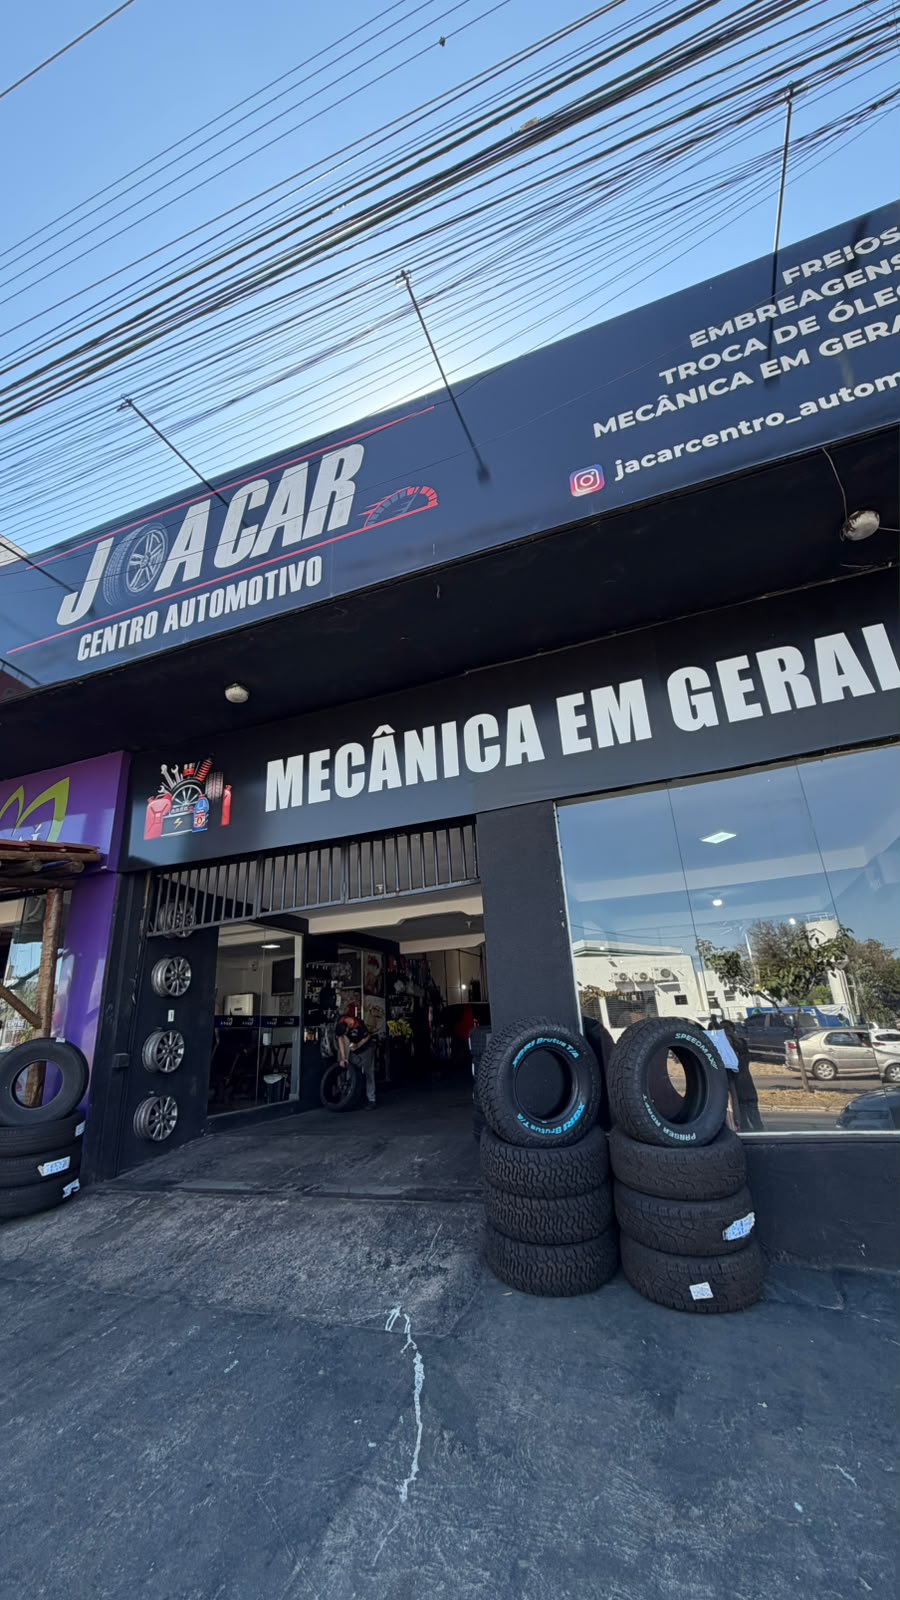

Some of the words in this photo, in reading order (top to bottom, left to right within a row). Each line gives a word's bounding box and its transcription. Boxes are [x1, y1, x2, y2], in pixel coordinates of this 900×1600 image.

[659, 337, 768, 385] TROCA
[773, 315, 821, 345] DE
[827, 284, 900, 323] ÓLE
[593, 371, 754, 438] MECÂNICA
[760, 349, 810, 379] EM
[213, 443, 366, 569] CAR
[77, 611, 158, 662] CENTRO
[163, 555, 323, 635] AUTOMOTIVO
[265, 703, 545, 813] MECÂNICA
[556, 678, 652, 756] EM
[667, 623, 900, 732] GERAL
[536, 1037, 567, 1048] Brutus
[530, 1124, 562, 1135] Brutus
